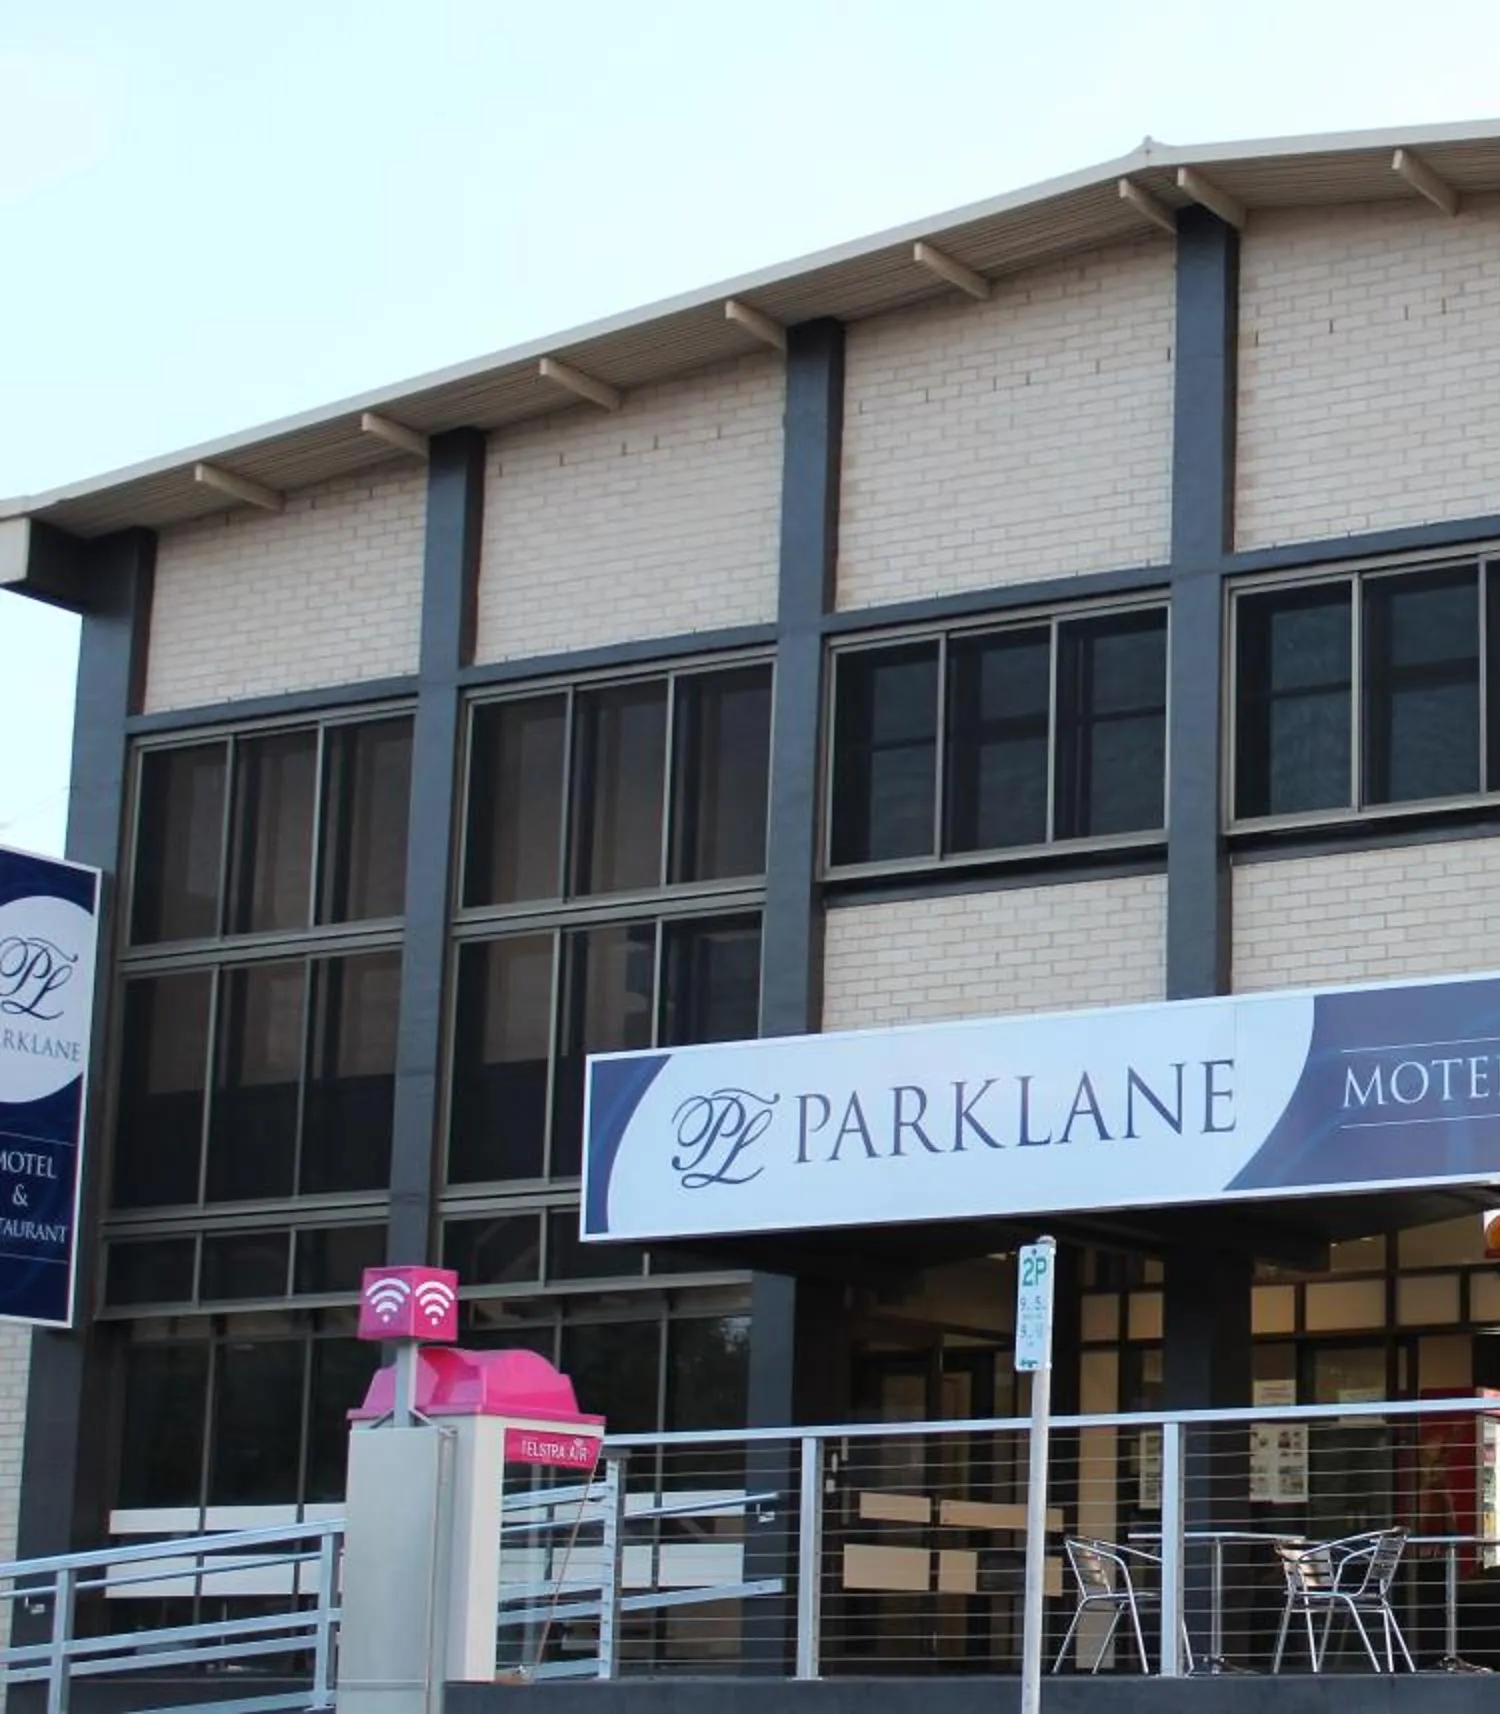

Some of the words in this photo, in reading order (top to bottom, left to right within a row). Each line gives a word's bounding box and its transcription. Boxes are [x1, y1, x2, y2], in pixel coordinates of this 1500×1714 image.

[791, 1057, 1238, 1165] PARKLANE
[12, 1183, 28, 1207] &
[1022, 1257, 1047, 1287] 2P
[521, 1439, 565, 1459] TELSTRA
